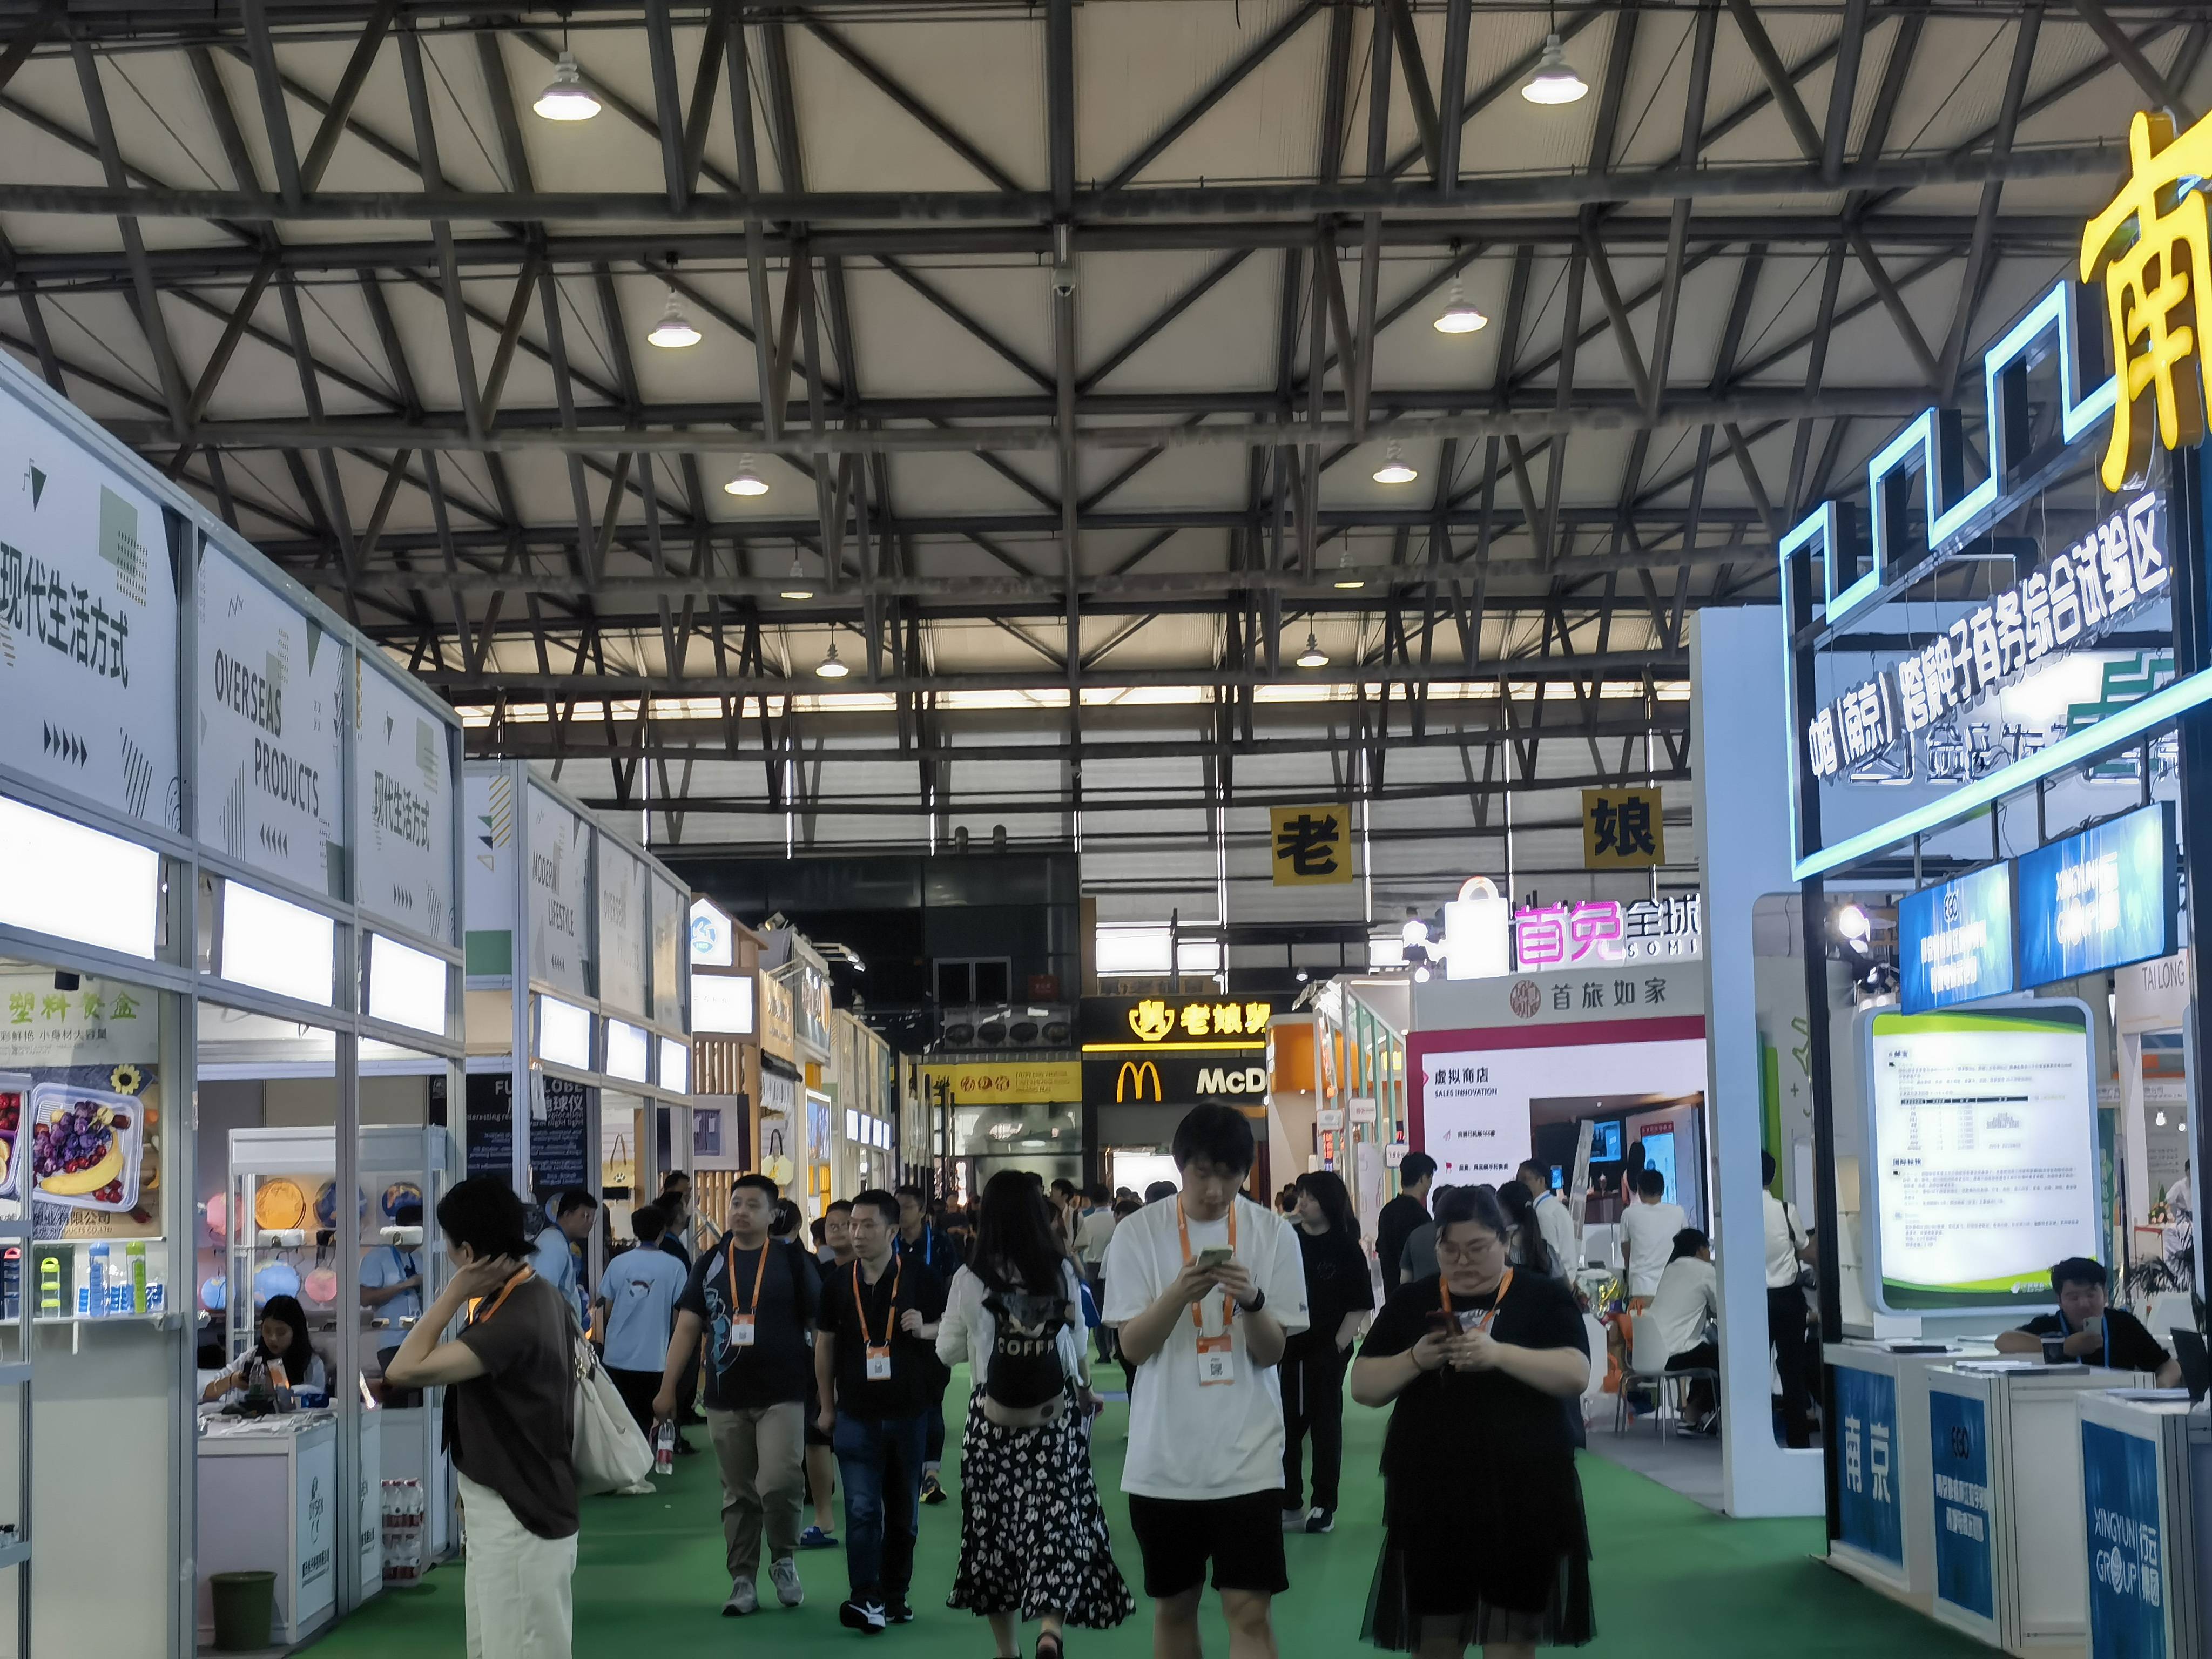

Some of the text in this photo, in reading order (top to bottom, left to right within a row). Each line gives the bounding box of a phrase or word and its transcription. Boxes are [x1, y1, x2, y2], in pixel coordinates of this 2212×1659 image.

[0, 541, 128, 689] 现代生活方式
[215, 648, 281, 738] OVERSEAS
[255, 737, 319, 818] PRODUCTS
[373, 770, 429, 853] 现代生活方式
[1591, 797, 1656, 857] 娘
[532, 851, 558, 894] MODERN
[1277, 814, 1339, 876] 老
[548, 897, 574, 938] LIFESTYLE
[1551, 976, 1667, 1010] 首旅如家
[1845, 1414, 1891, 1504] 南京
[2094, 1506, 2136, 1550] XINGYUN
